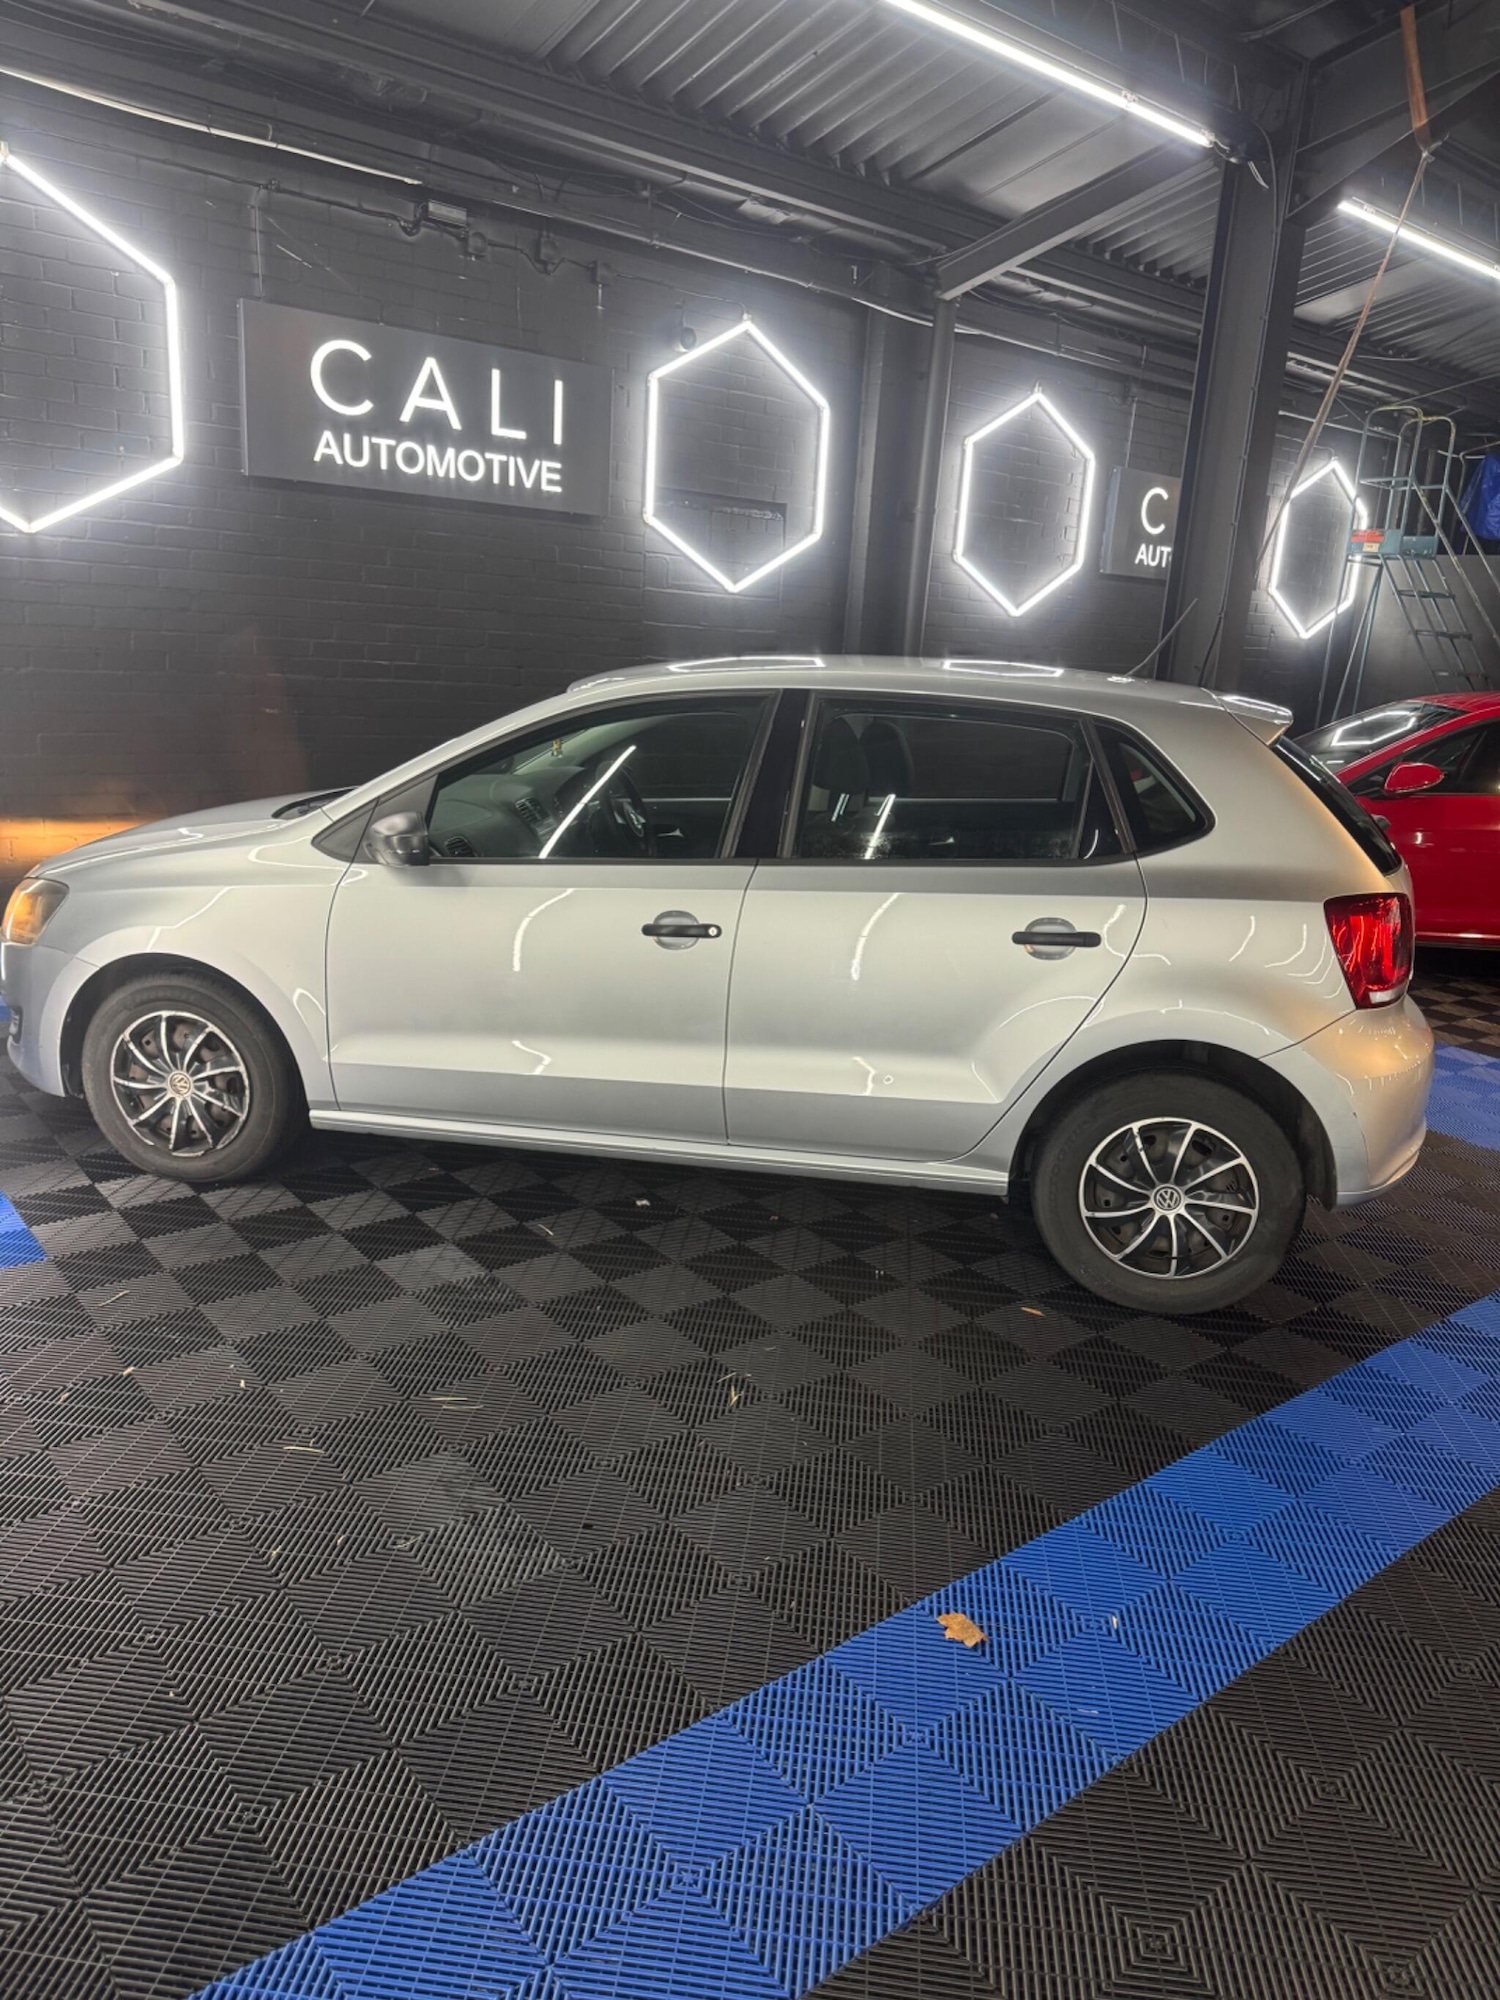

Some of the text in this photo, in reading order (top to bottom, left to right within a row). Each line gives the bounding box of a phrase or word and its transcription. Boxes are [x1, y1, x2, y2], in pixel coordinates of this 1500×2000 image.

[311, 338, 564, 446] CALI
[313, 429, 563, 493] AUTOMOTIVE
[1134, 543, 1173, 568] AUT
